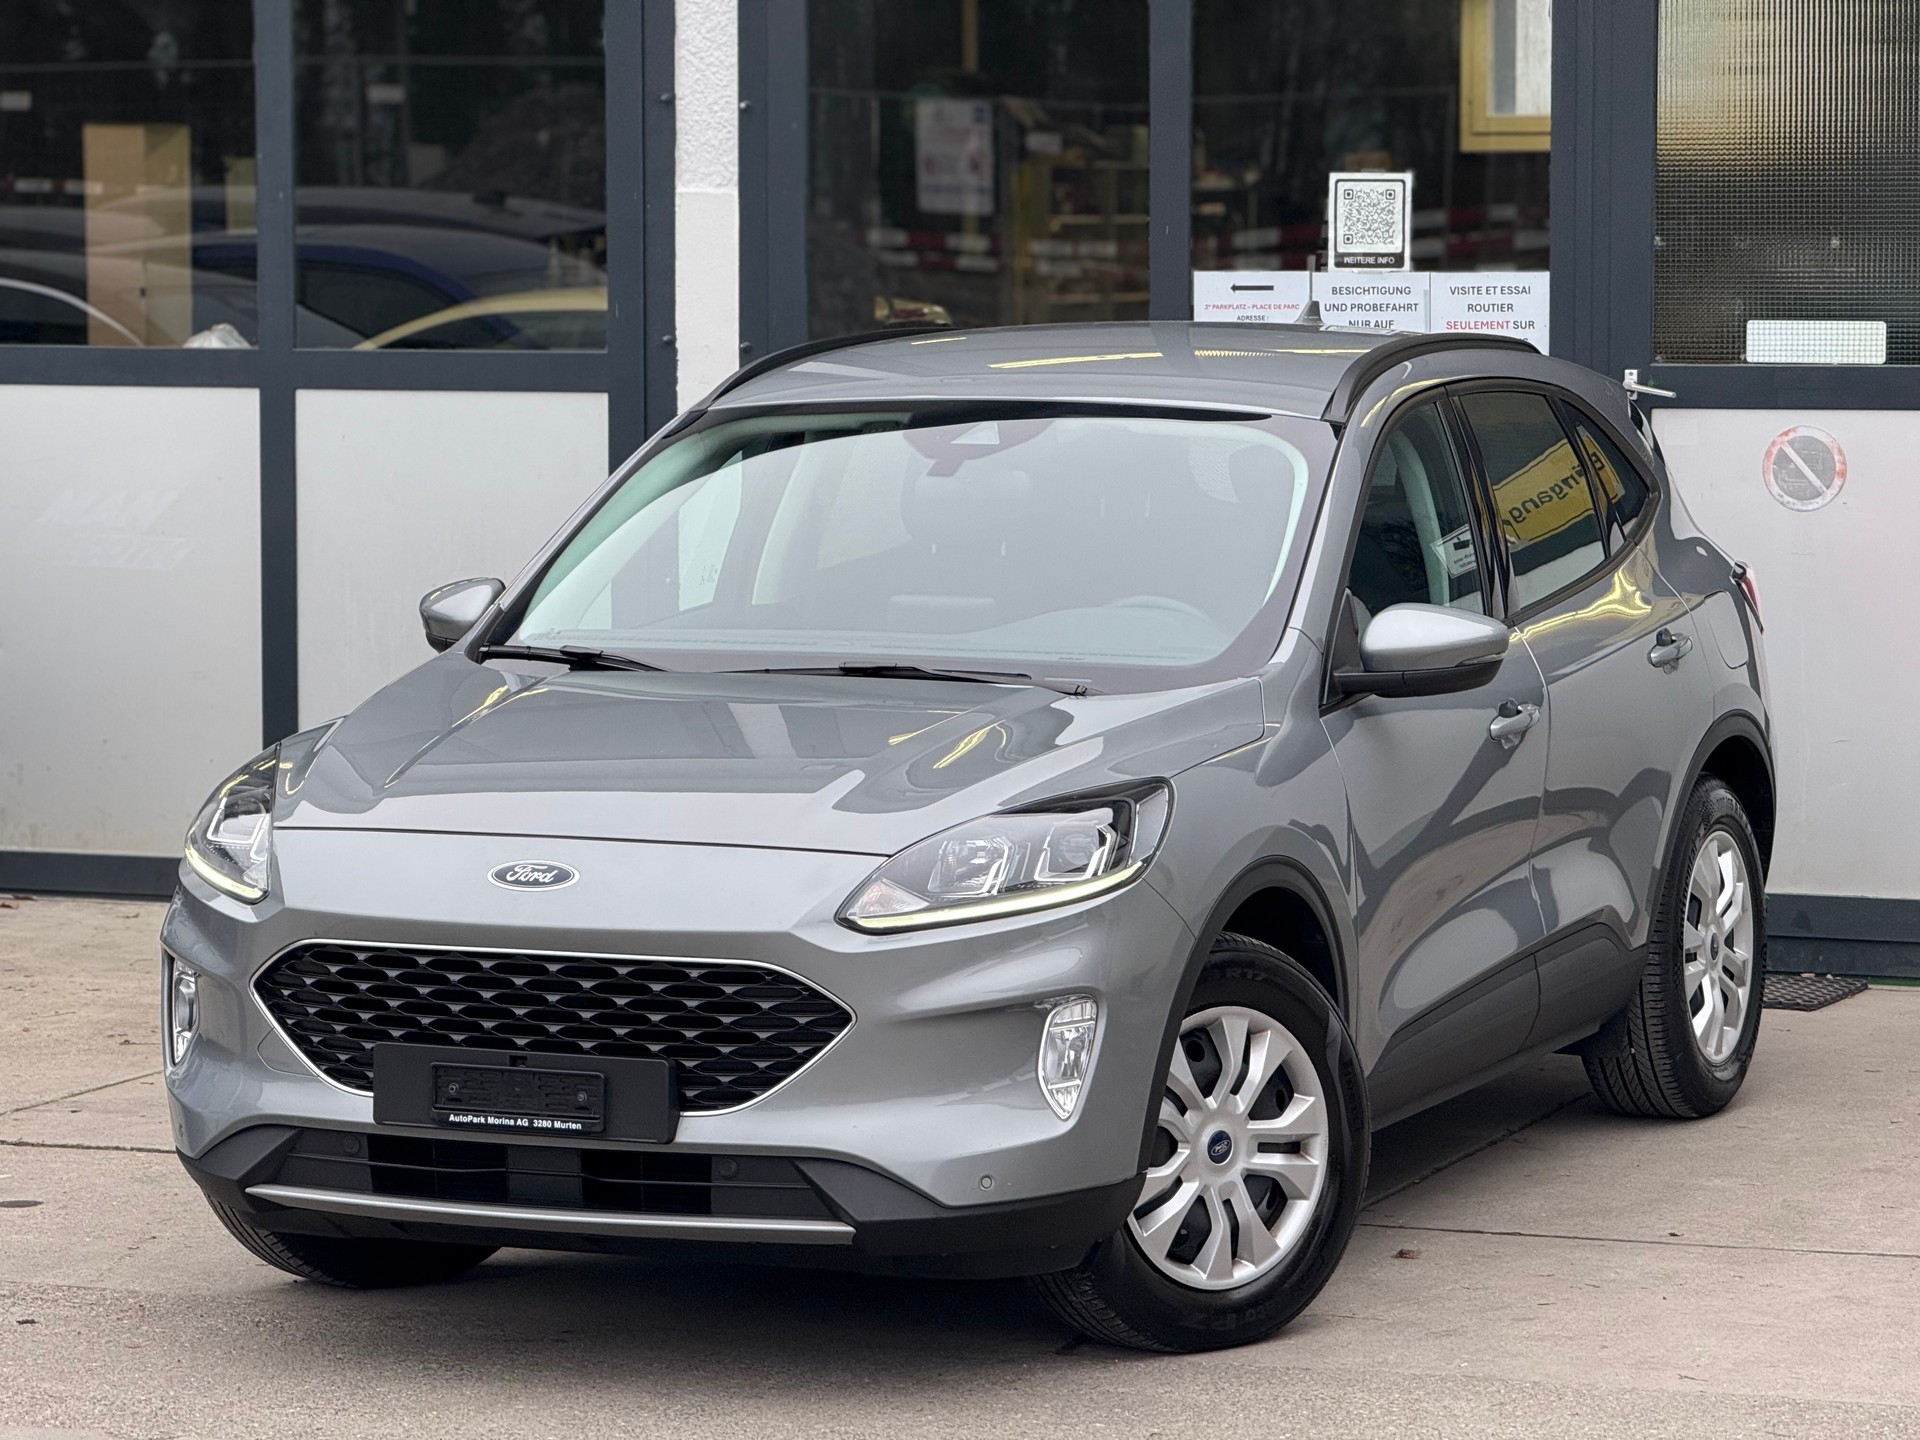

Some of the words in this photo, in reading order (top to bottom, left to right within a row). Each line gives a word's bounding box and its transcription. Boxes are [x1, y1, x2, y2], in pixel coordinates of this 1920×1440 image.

[1343, 256, 1376, 264] WEITERE
[1377, 256, 1395, 264] INFO
[1331, 286, 1412, 295] BESICHTIGUNG
[1449, 286, 1483, 295] VISITE
[1485, 286, 1498, 295] ET
[1500, 285, 1531, 295] ESSAI
[1324, 303, 1348, 312] UND
[1350, 303, 1419, 312] PROBEFAHRT
[1467, 303, 1514, 313] ROUTIER
[1373, 320, 1395, 329] AUF
[1446, 320, 1511, 330] SEULEMENT
[1512, 320, 1535, 330] SUR
[506, 864, 558, 883] Ford
[449, 1114, 486, 1124] AutoPark
[487, 1115, 515, 1126] Morina
[516, 1118, 529, 1127] AG
[533, 1119, 552, 1128] 3280
[553, 1120, 582, 1130] Murten
